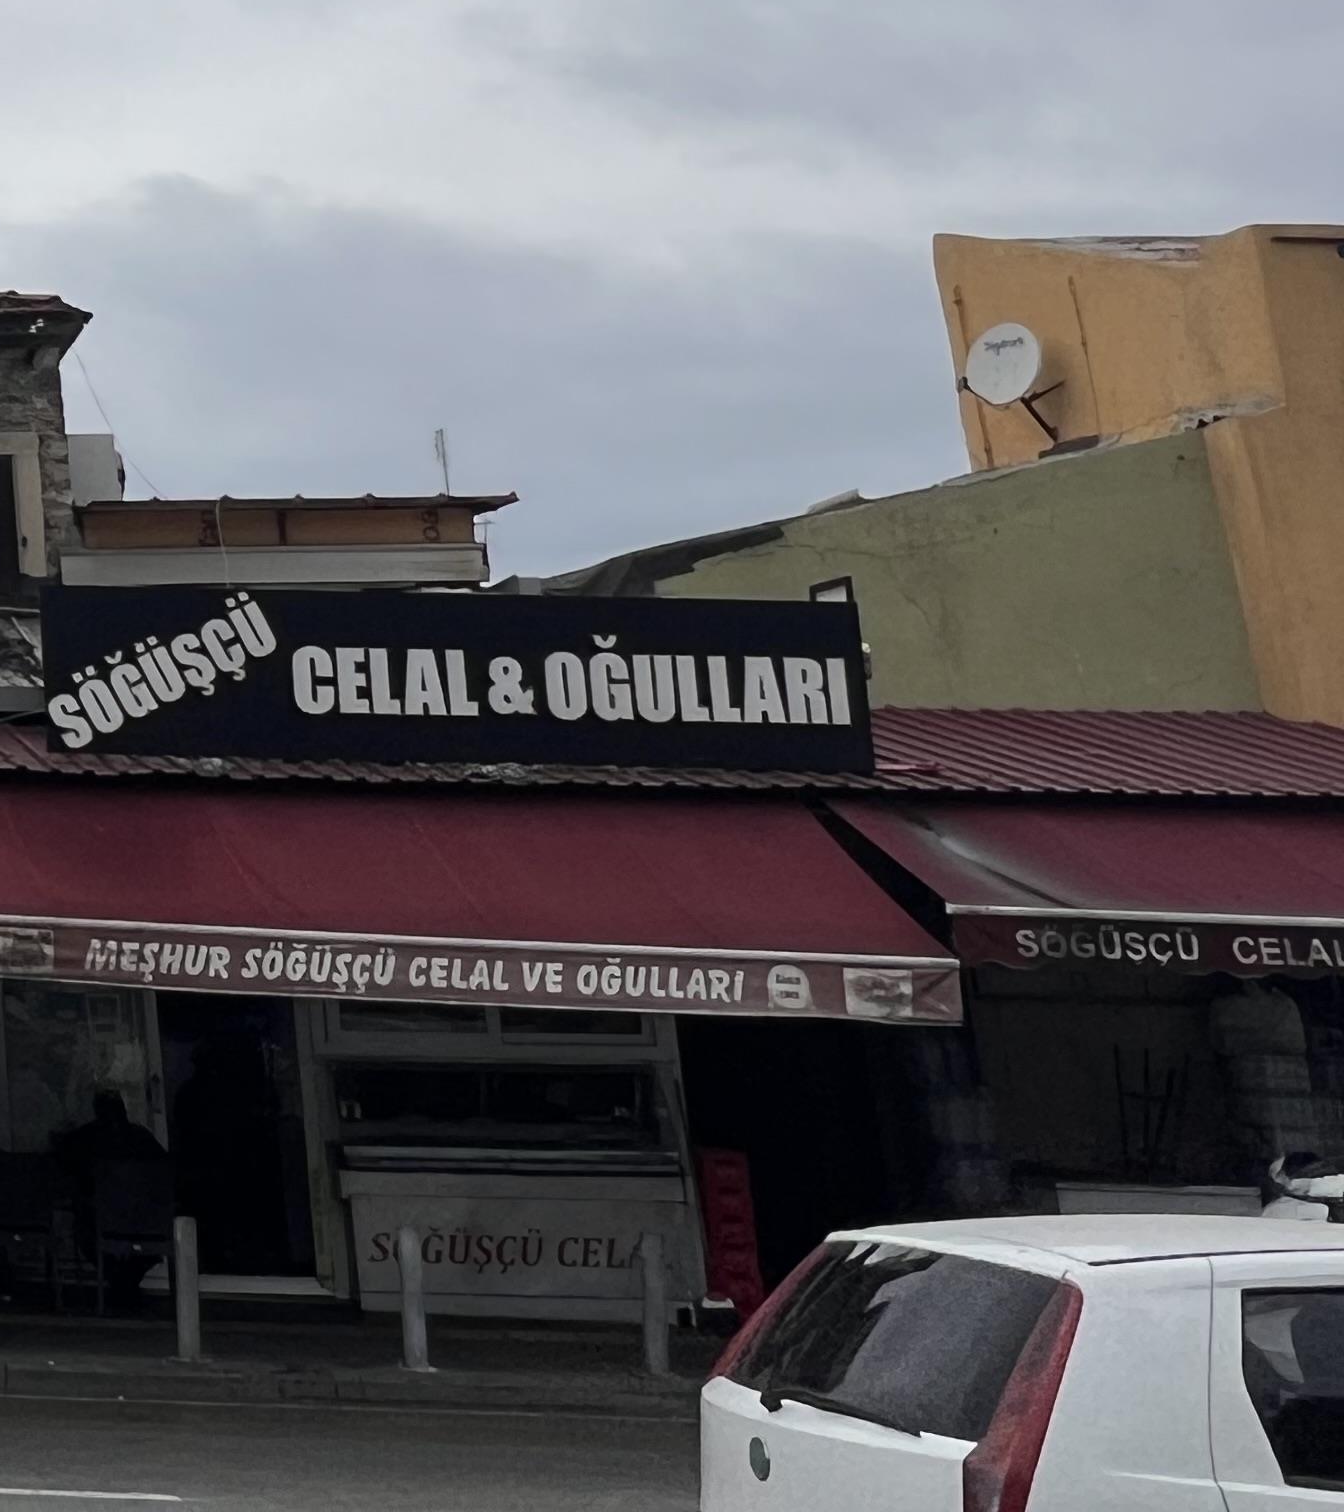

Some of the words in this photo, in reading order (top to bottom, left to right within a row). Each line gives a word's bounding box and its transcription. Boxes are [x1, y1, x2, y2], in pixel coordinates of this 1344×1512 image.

[47, 591, 277, 749] SÖĞÜŞÇÜ
[291, 645, 479, 716] CELAL
[488, 656, 537, 715] &
[544, 634, 852, 725] OĞULLARI
[85, 938, 231, 983] MEŞHUR
[240, 941, 396, 994] SÖĞÜŞÇÜ
[409, 956, 510, 991] CELAL
[521, 961, 562, 994] VE
[576, 957, 745, 1003] OĞULLARI
